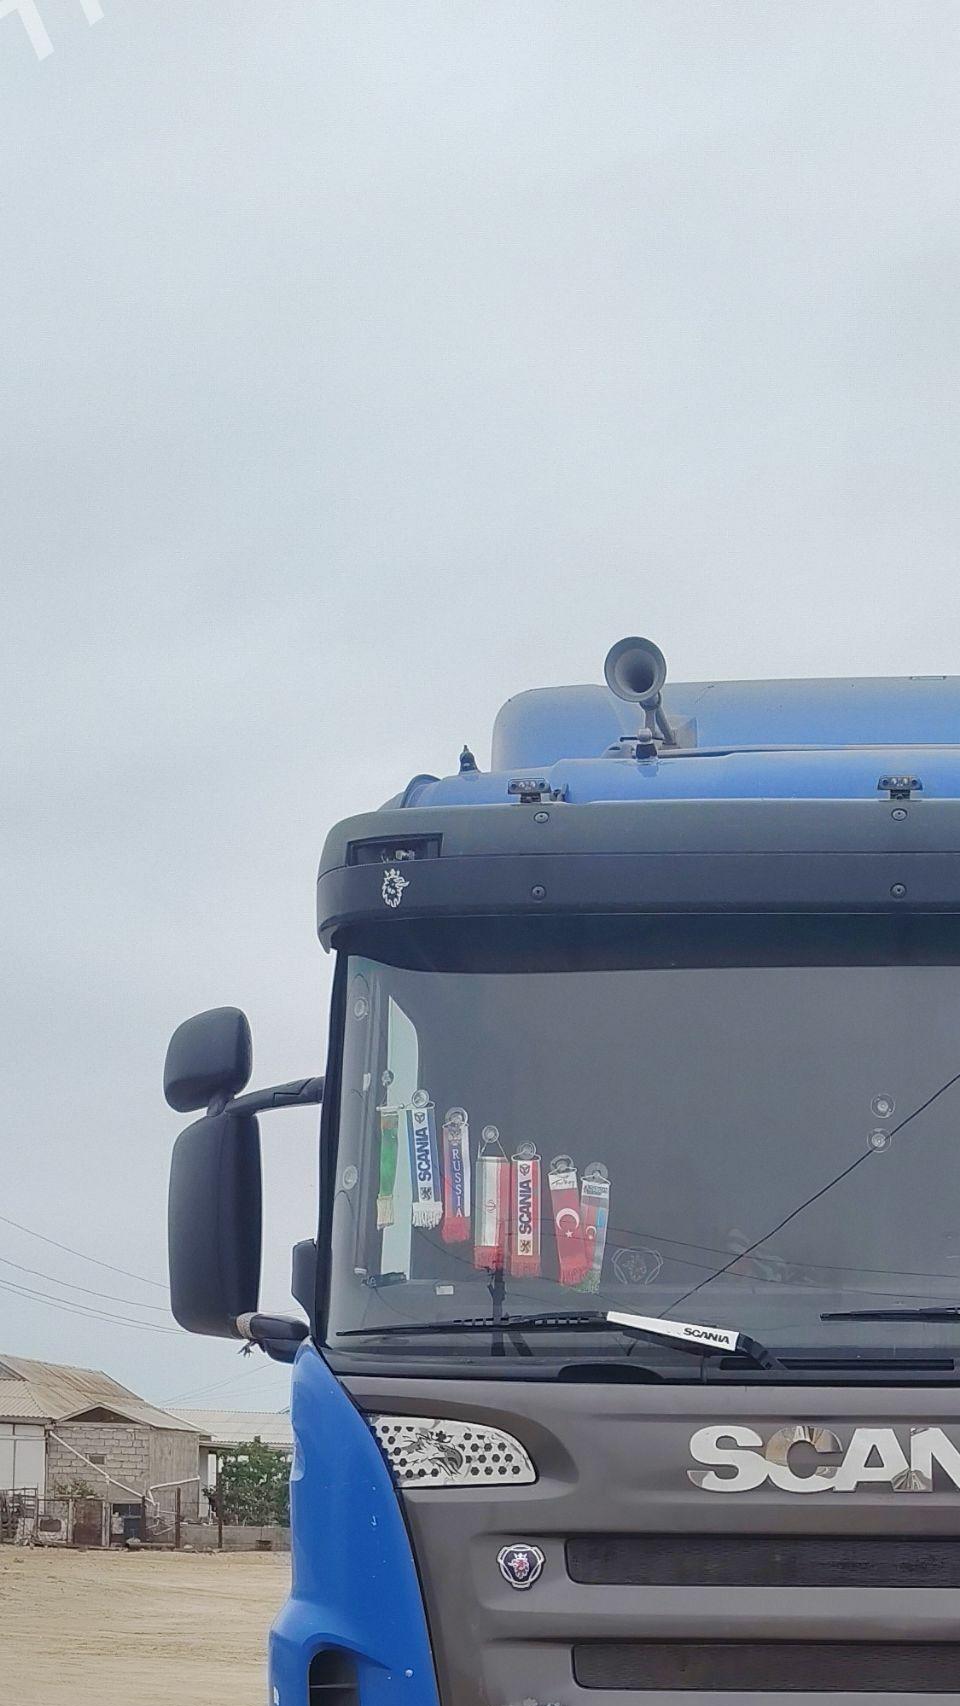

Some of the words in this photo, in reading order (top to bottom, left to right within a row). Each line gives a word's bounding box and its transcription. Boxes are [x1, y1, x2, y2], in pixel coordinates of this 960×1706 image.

[415, 1127, 431, 1182] SCANIA
[452, 1148, 462, 1217] RUSSIA
[519, 1179, 532, 1235] SCANIA
[683, 1327, 730, 1345] SCANIA
